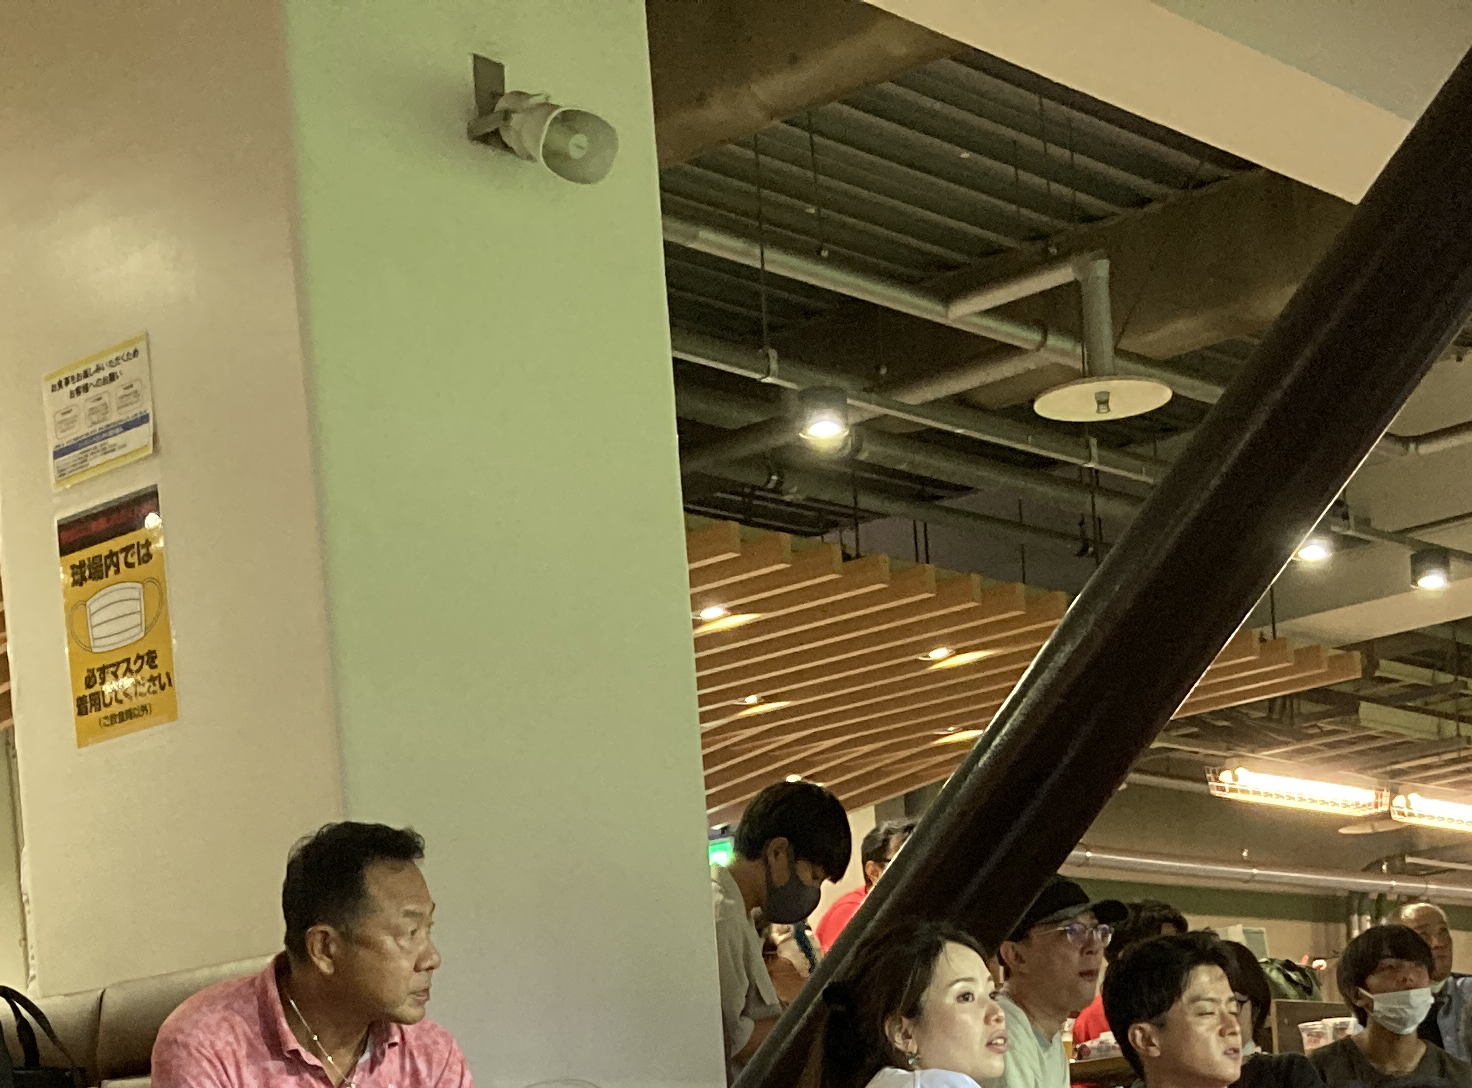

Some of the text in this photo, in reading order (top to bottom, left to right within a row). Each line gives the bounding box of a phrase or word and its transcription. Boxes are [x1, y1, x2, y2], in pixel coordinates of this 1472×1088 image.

[70, 538, 153, 587] 球場内では
[84, 649, 158, 690] 必ずマスクを
